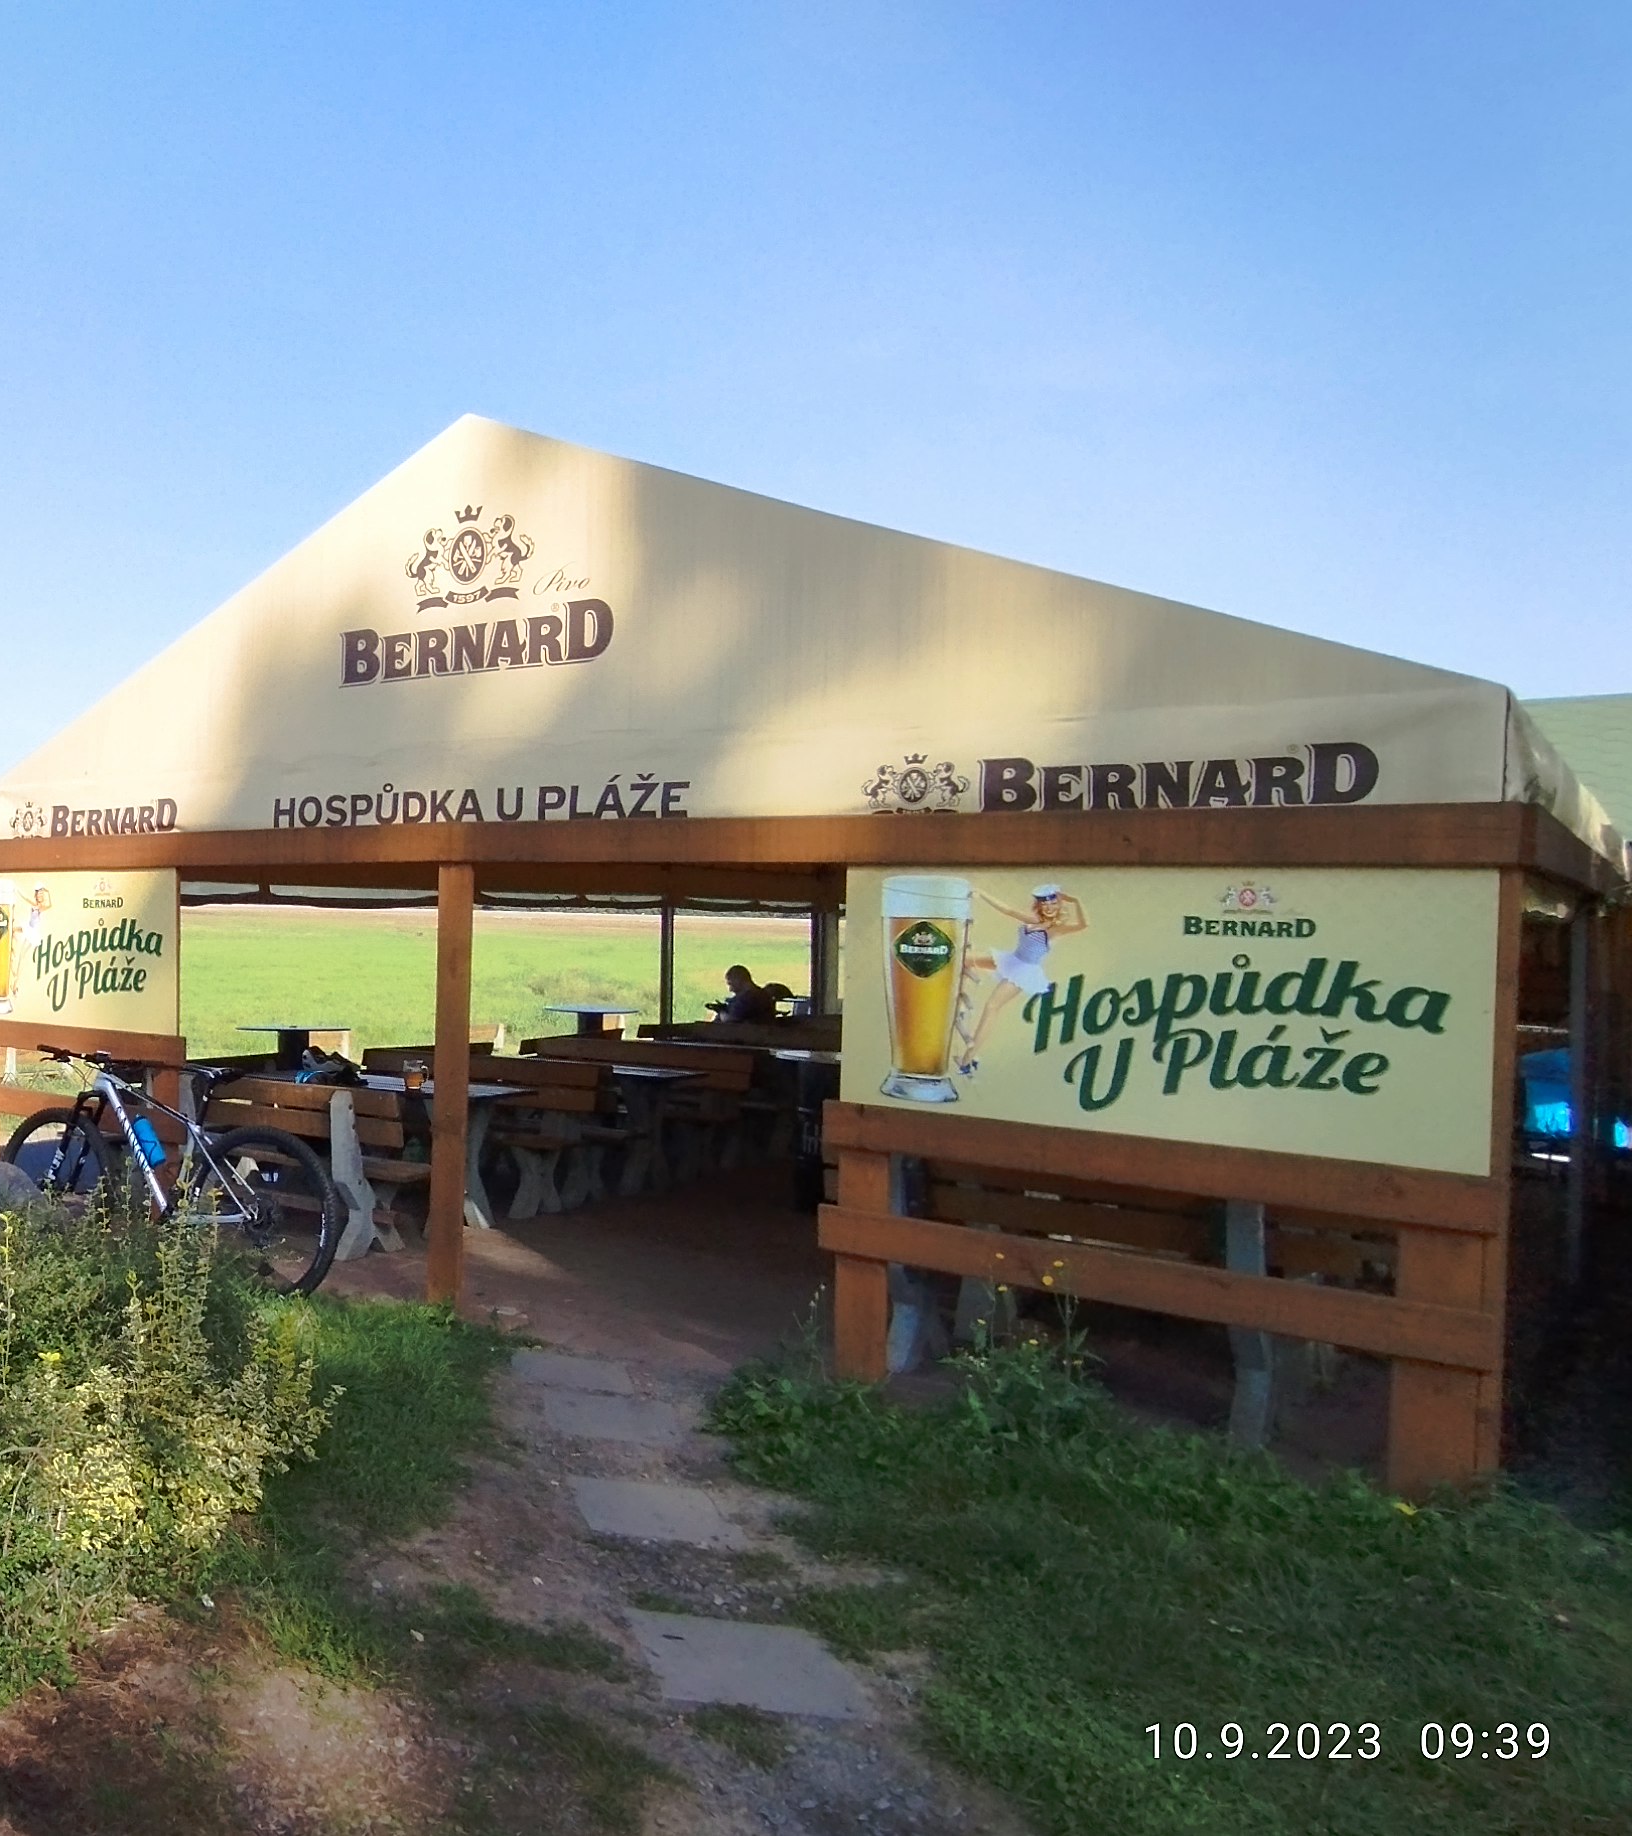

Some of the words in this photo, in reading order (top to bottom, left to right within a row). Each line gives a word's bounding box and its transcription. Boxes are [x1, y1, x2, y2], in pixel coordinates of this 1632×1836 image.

[452, 590, 481, 604] 1597
[533, 561, 591, 596] Pivo
[338, 599, 615, 688] BERNARD
[272, 782, 486, 829] HOSPŮDKA
[496, 786, 524, 822] U
[537, 773, 691, 821] PLÁŽE
[976, 742, 1380, 813] BERNARD
[50, 798, 178, 838] BERNARD
[82, 896, 124, 909] BERNARD
[1182, 915, 1317, 939] BERNARD
[32, 917, 164, 981] Hospůdka
[46, 968, 70, 1013] U
[74, 955, 148, 1001] Pláže
[1022, 953, 1452, 1054] Hospůdka
[1063, 1035, 1136, 1113] U
[1151, 1024, 1391, 1097] Pláže
